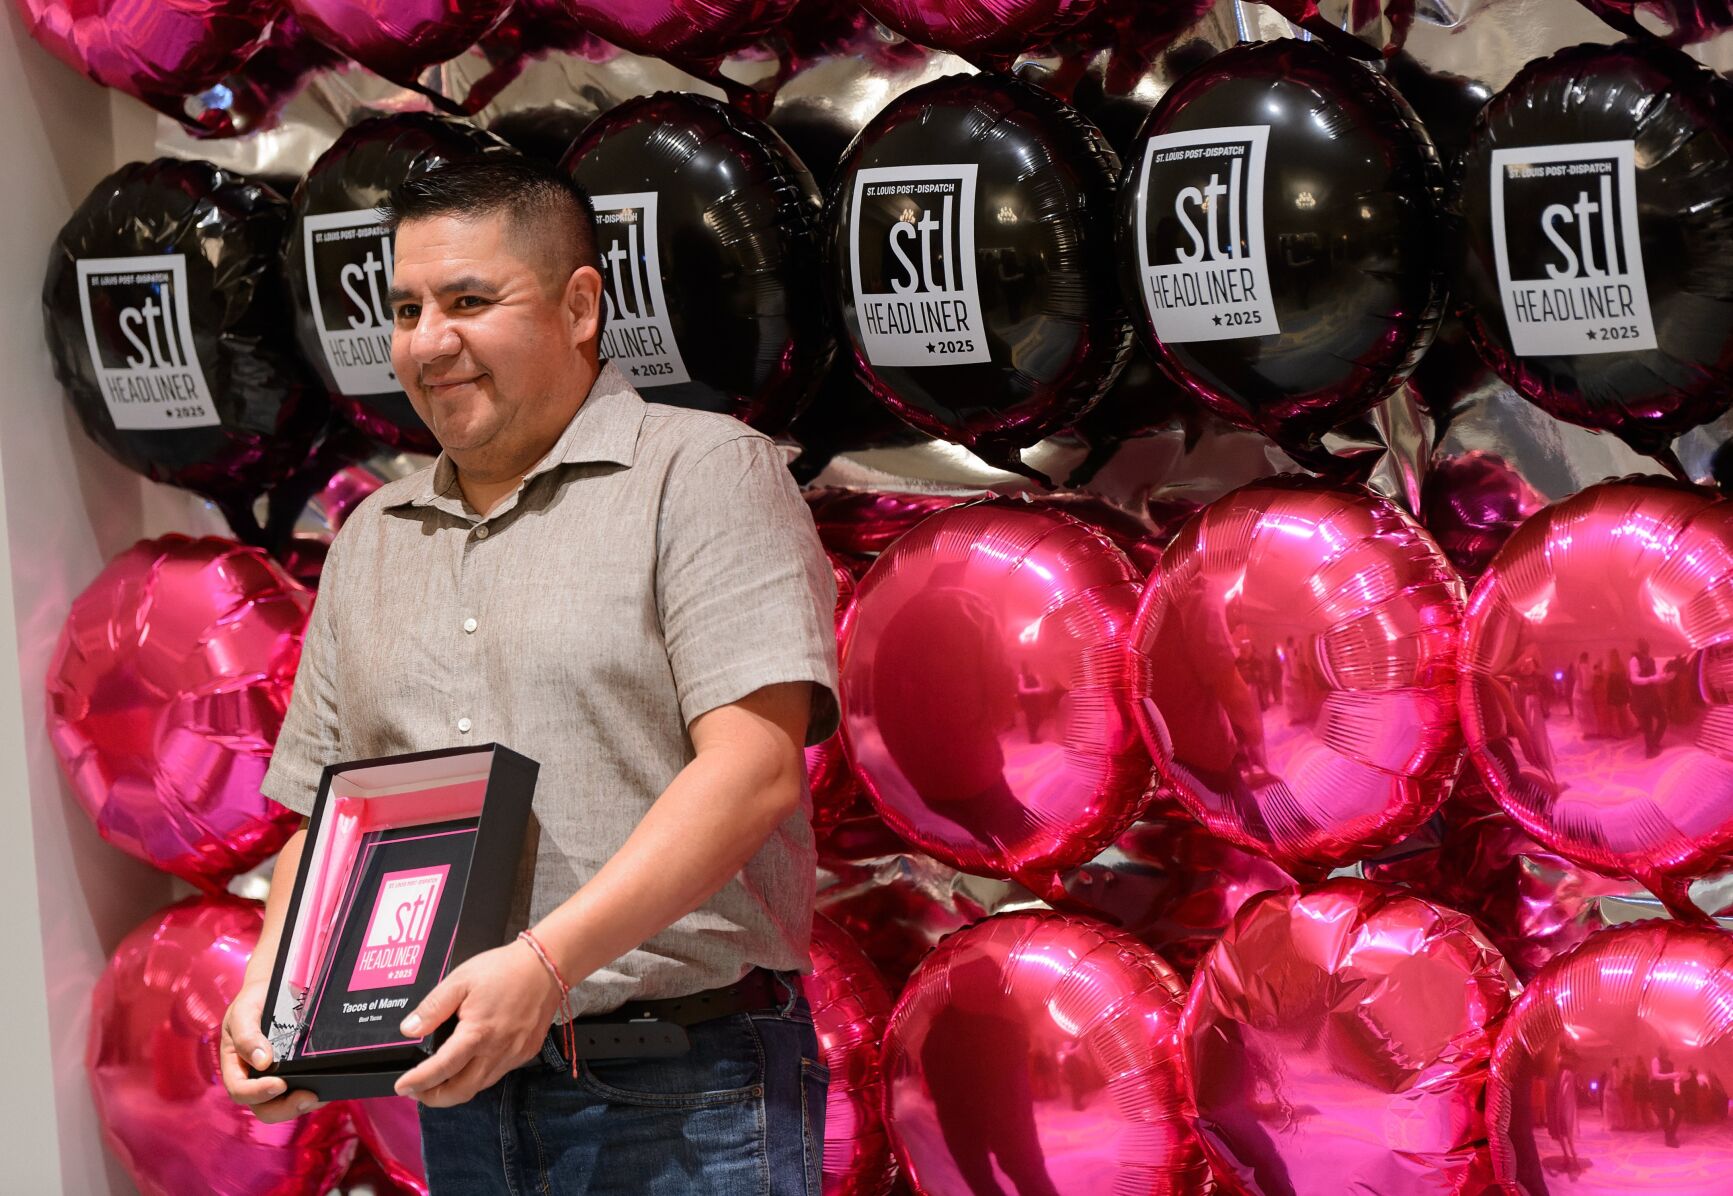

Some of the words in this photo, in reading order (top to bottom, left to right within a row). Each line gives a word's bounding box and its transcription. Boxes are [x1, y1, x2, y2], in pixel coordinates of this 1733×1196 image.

[1156, 154, 1164, 163] ST.
[1165, 151, 1184, 162] LOUIS
[1185, 146, 1244, 159] POST-DISPATCH
[1522, 166, 1544, 178] LOUIS
[1545, 163, 1611, 176] POST-DISPATCH
[867, 187, 876, 196] ST.
[877, 185, 896, 195] LOUIS
[897, 183, 955, 194] POST-DISPATCH
[1175, 158, 1242, 263] stl
[1541, 175, 1619, 279] stl
[889, 195, 954, 294] stl
[1150, 268, 1257, 309] HEADLINER
[864, 300, 970, 334] HEADLINER
[1513, 284, 1635, 323] HEADLINER
[119, 284, 181, 369] stl
[1225, 310, 1262, 326] 2025
[1600, 325, 1640, 340] 2025
[329, 334, 391, 367] HEADLIN
[938, 340, 974, 353] 2025
[641, 362, 674, 376] 2025
[106, 373, 199, 403] HEADLINER
[176, 407, 205, 418] 2025
[388, 885, 435, 944] stl
[359, 944, 420, 971] HEADLINER
[393, 969, 413, 979] 2025
[342, 1003, 368, 1013] Tacos
[369, 1000, 378, 1010] el
[378, 998, 409, 1009] Manny
